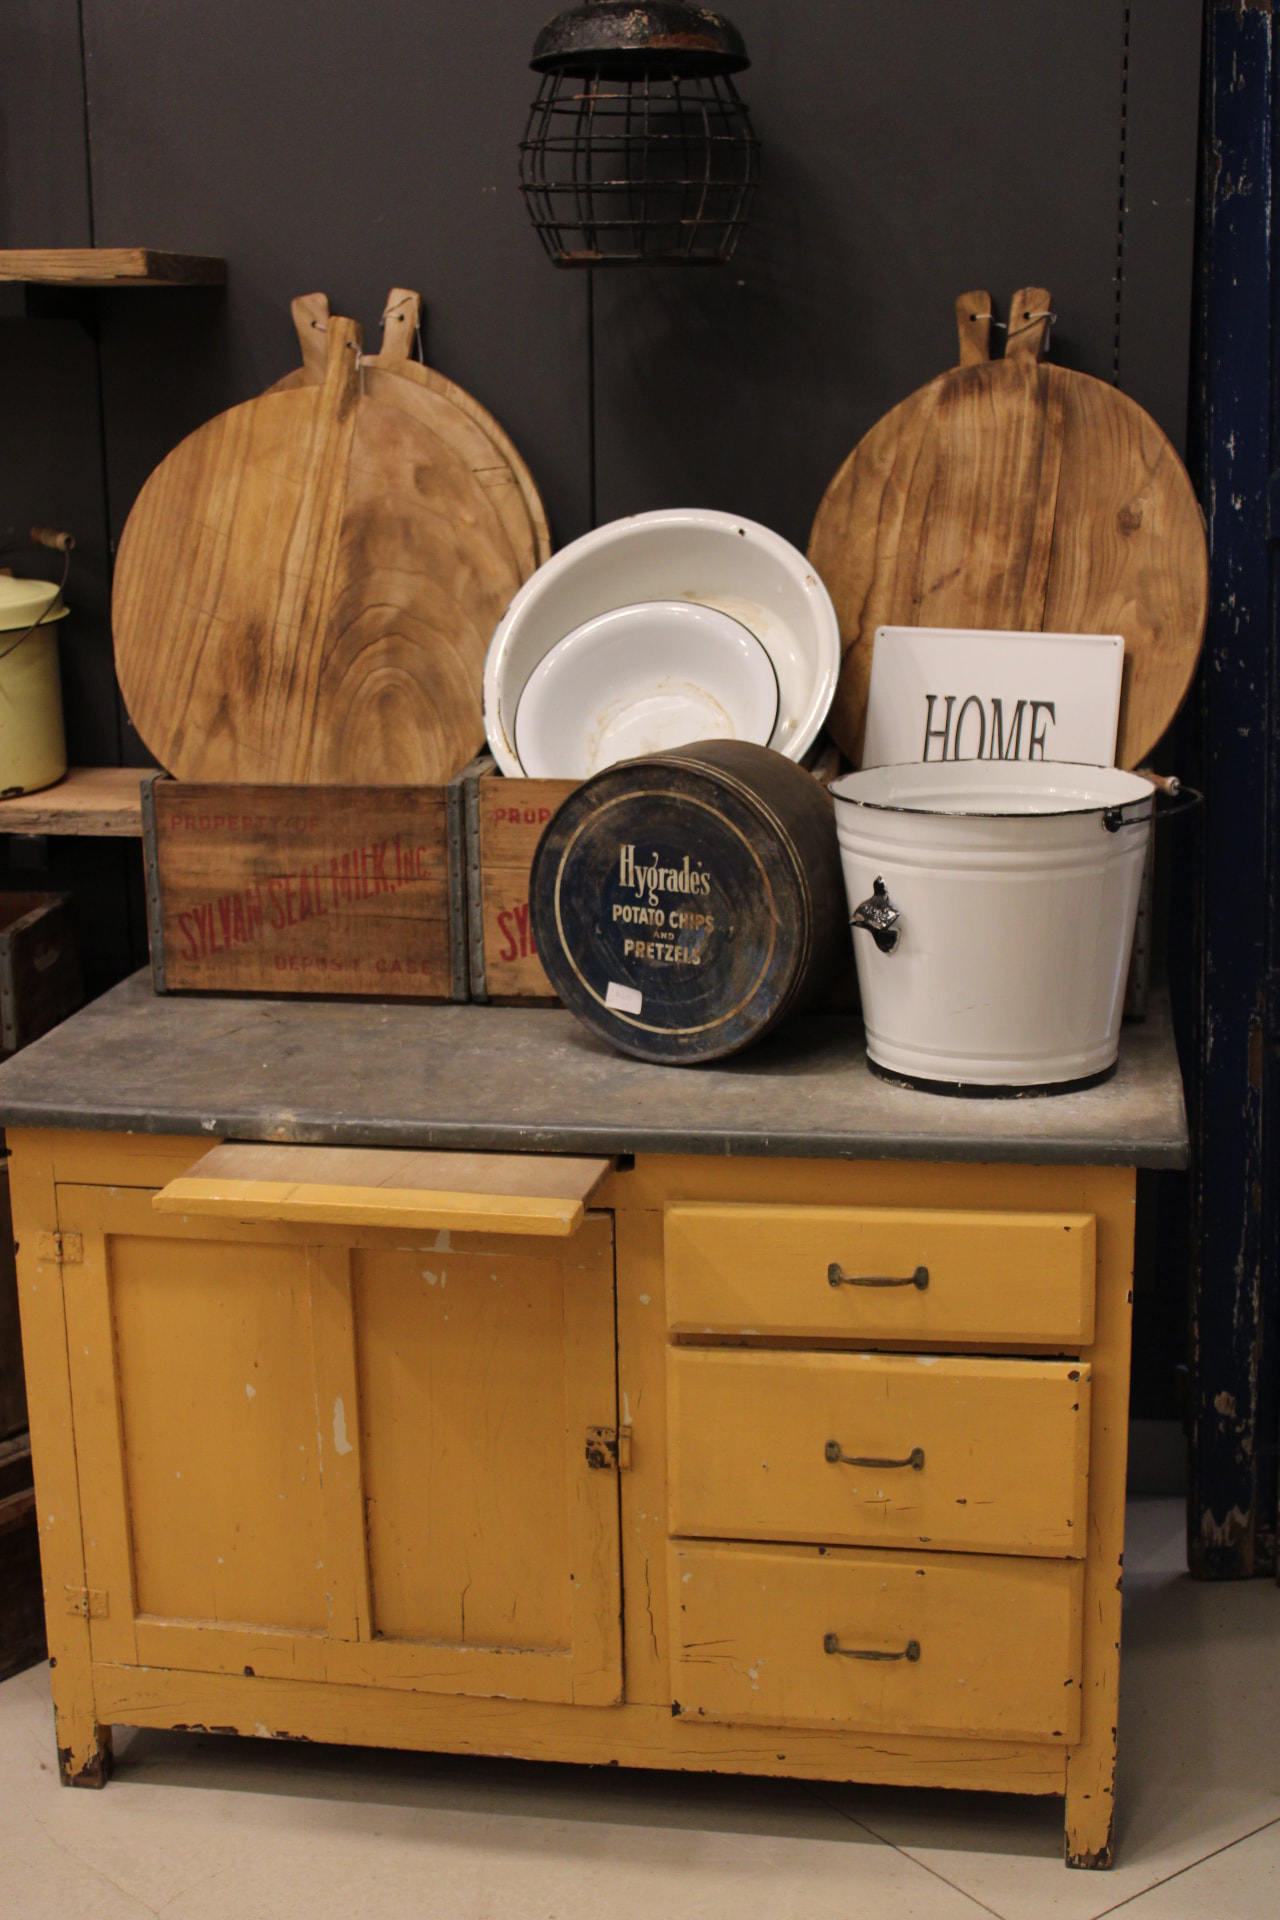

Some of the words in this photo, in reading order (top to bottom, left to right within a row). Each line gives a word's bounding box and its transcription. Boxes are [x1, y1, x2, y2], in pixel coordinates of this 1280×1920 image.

[923, 694, 1056, 762] HOME
[171, 814, 283, 832] PROPERTY
[297, 815, 320, 832] OF
[619, 843, 711, 907] Hygrade's
[178, 884, 264, 962] SYLVAN
[268, 865, 328, 930] SEAL
[330, 839, 396, 909] MILK,
[612, 904, 665, 926] POTATO
[669, 911, 714, 934] CHIPS
[653, 931, 675, 940] AND
[274, 955, 362, 973] DEPOSIT
[376, 957, 433, 975] CASE
[624, 939, 701, 965] PRETZELS
